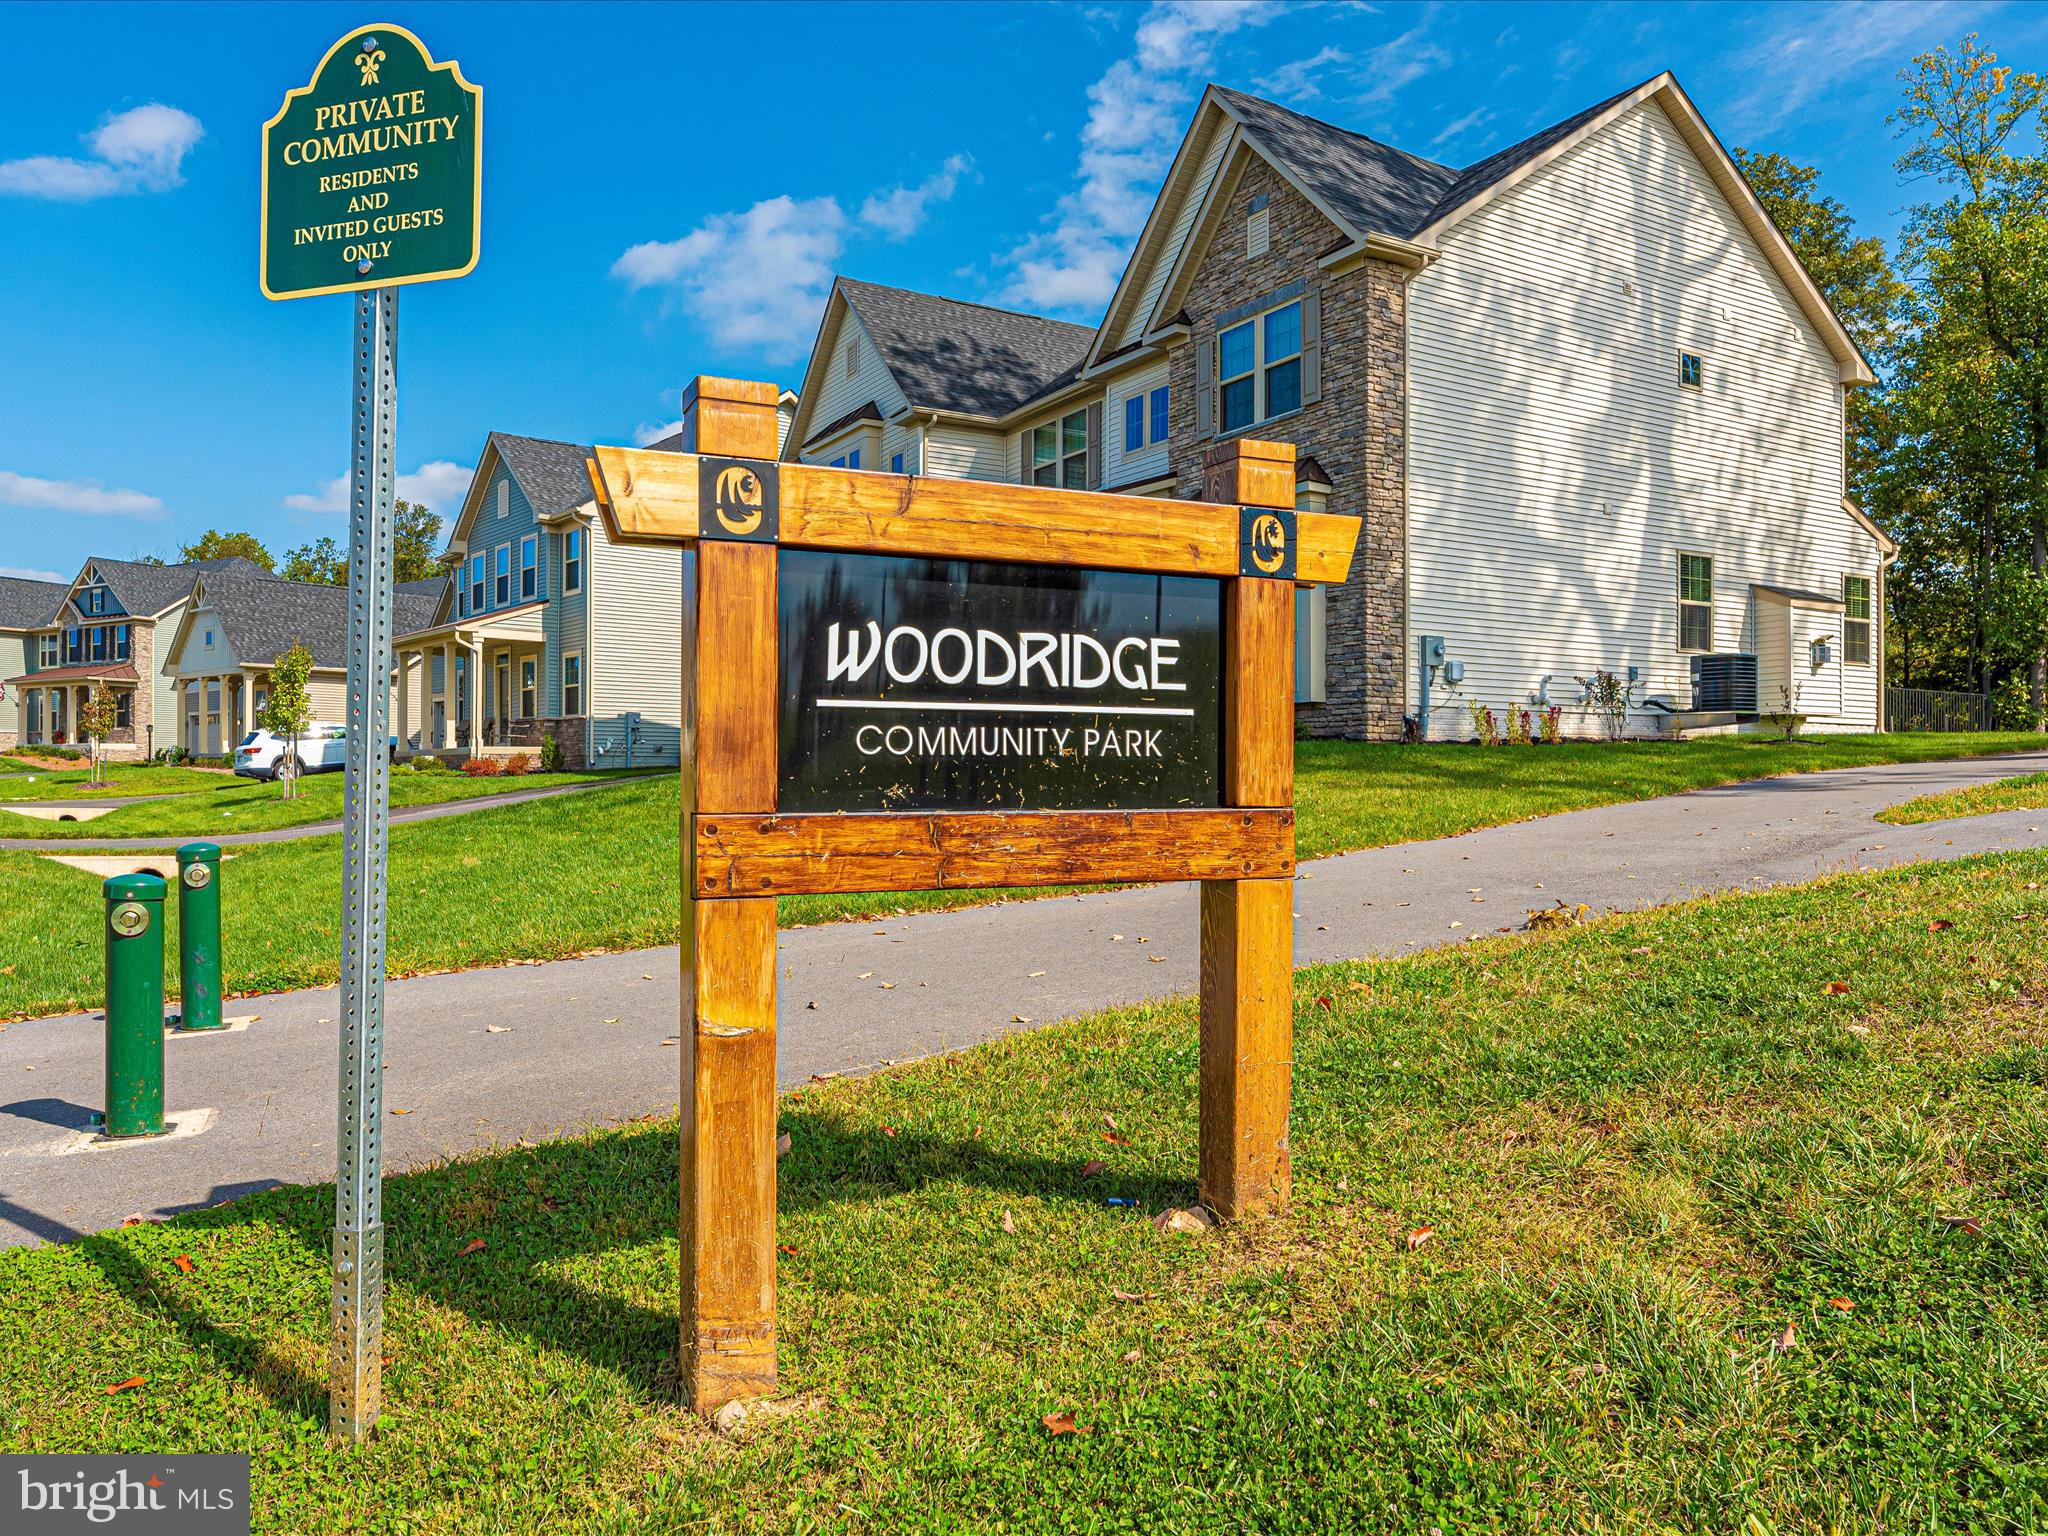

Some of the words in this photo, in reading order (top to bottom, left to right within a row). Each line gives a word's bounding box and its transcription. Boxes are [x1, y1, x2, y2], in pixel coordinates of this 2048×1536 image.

[315, 90, 425, 131] PRIVATE
[283, 115, 459, 166] COMMUNITY
[319, 162, 419, 192] RESIDENTS
[347, 192, 389, 213] AND
[294, 219, 369, 245] INVITED
[373, 208, 444, 234] GUESTS
[343, 240, 392, 262] ONLY
[826, 620, 1187, 691] WOODRIDGE
[855, 724, 1071, 756] COMMUNITY
[1083, 729, 1163, 757] PARK
